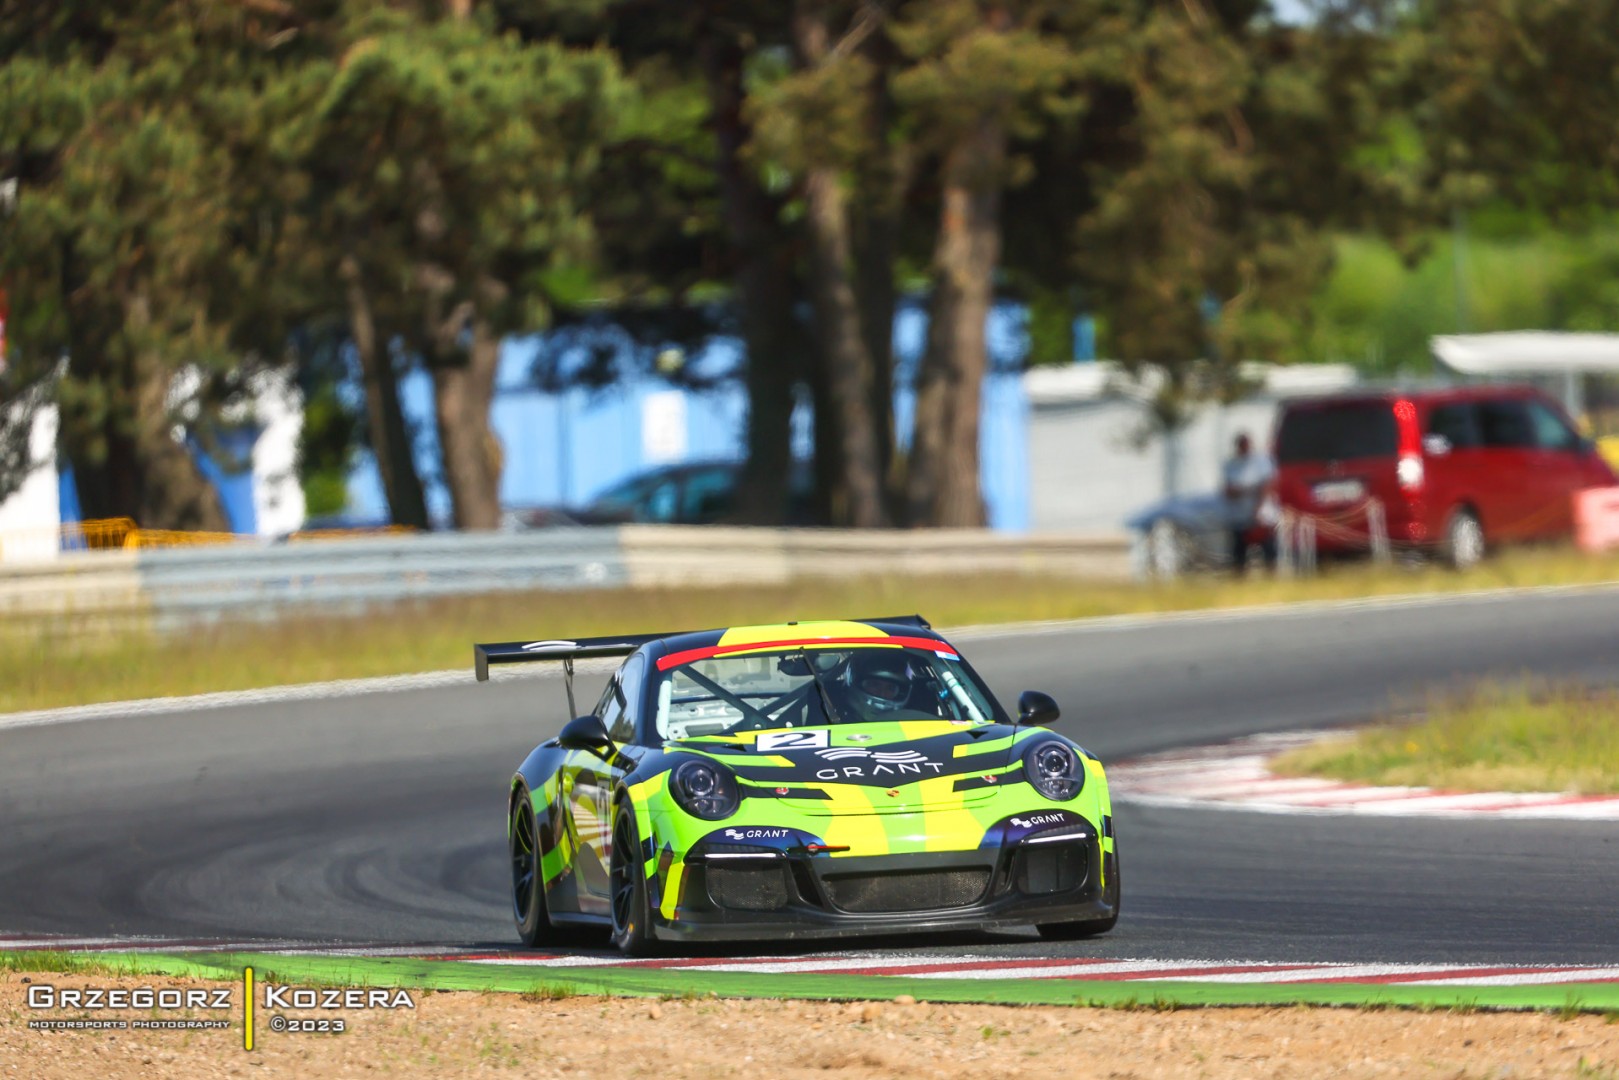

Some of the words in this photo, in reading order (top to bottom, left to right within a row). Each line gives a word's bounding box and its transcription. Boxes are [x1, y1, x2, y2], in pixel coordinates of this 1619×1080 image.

[770, 732, 817, 749] 2
[816, 762, 944, 780] GRANT
[1030, 813, 1065, 825] GRANT
[746, 829, 789, 838] GRANT
